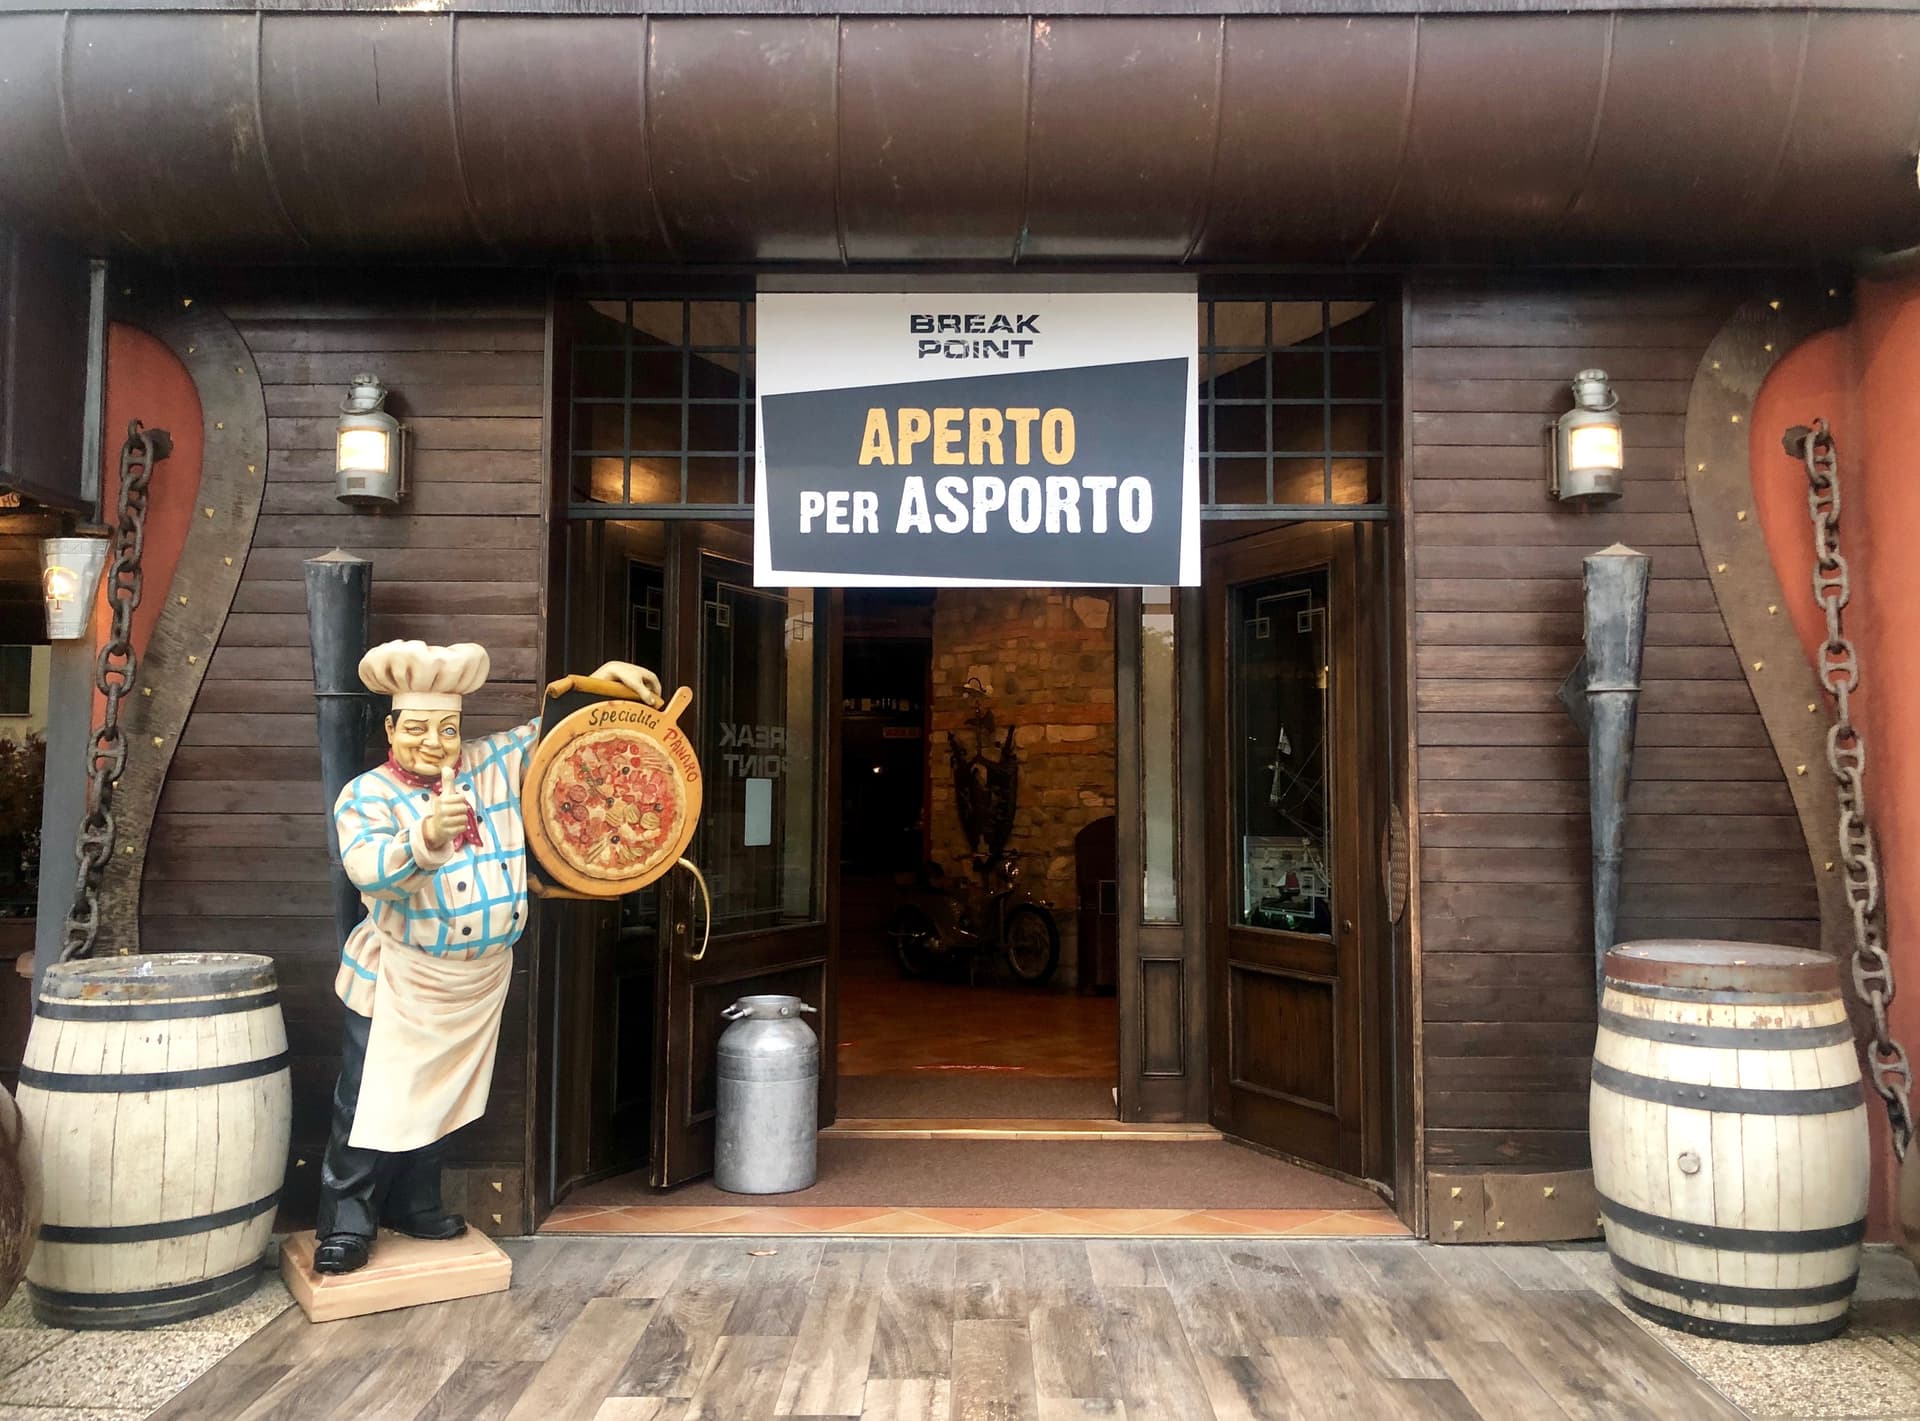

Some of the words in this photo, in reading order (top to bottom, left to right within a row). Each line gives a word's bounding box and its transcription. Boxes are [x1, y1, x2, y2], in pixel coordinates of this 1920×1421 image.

[910, 314, 1040, 334] BREAK
[918, 339, 1034, 359] POINT
[858, 407, 1075, 466] APERTO
[800, 490, 879, 534] PER
[896, 475, 1153, 534] ASPORTO
[663, 727, 698, 783] PANARO
